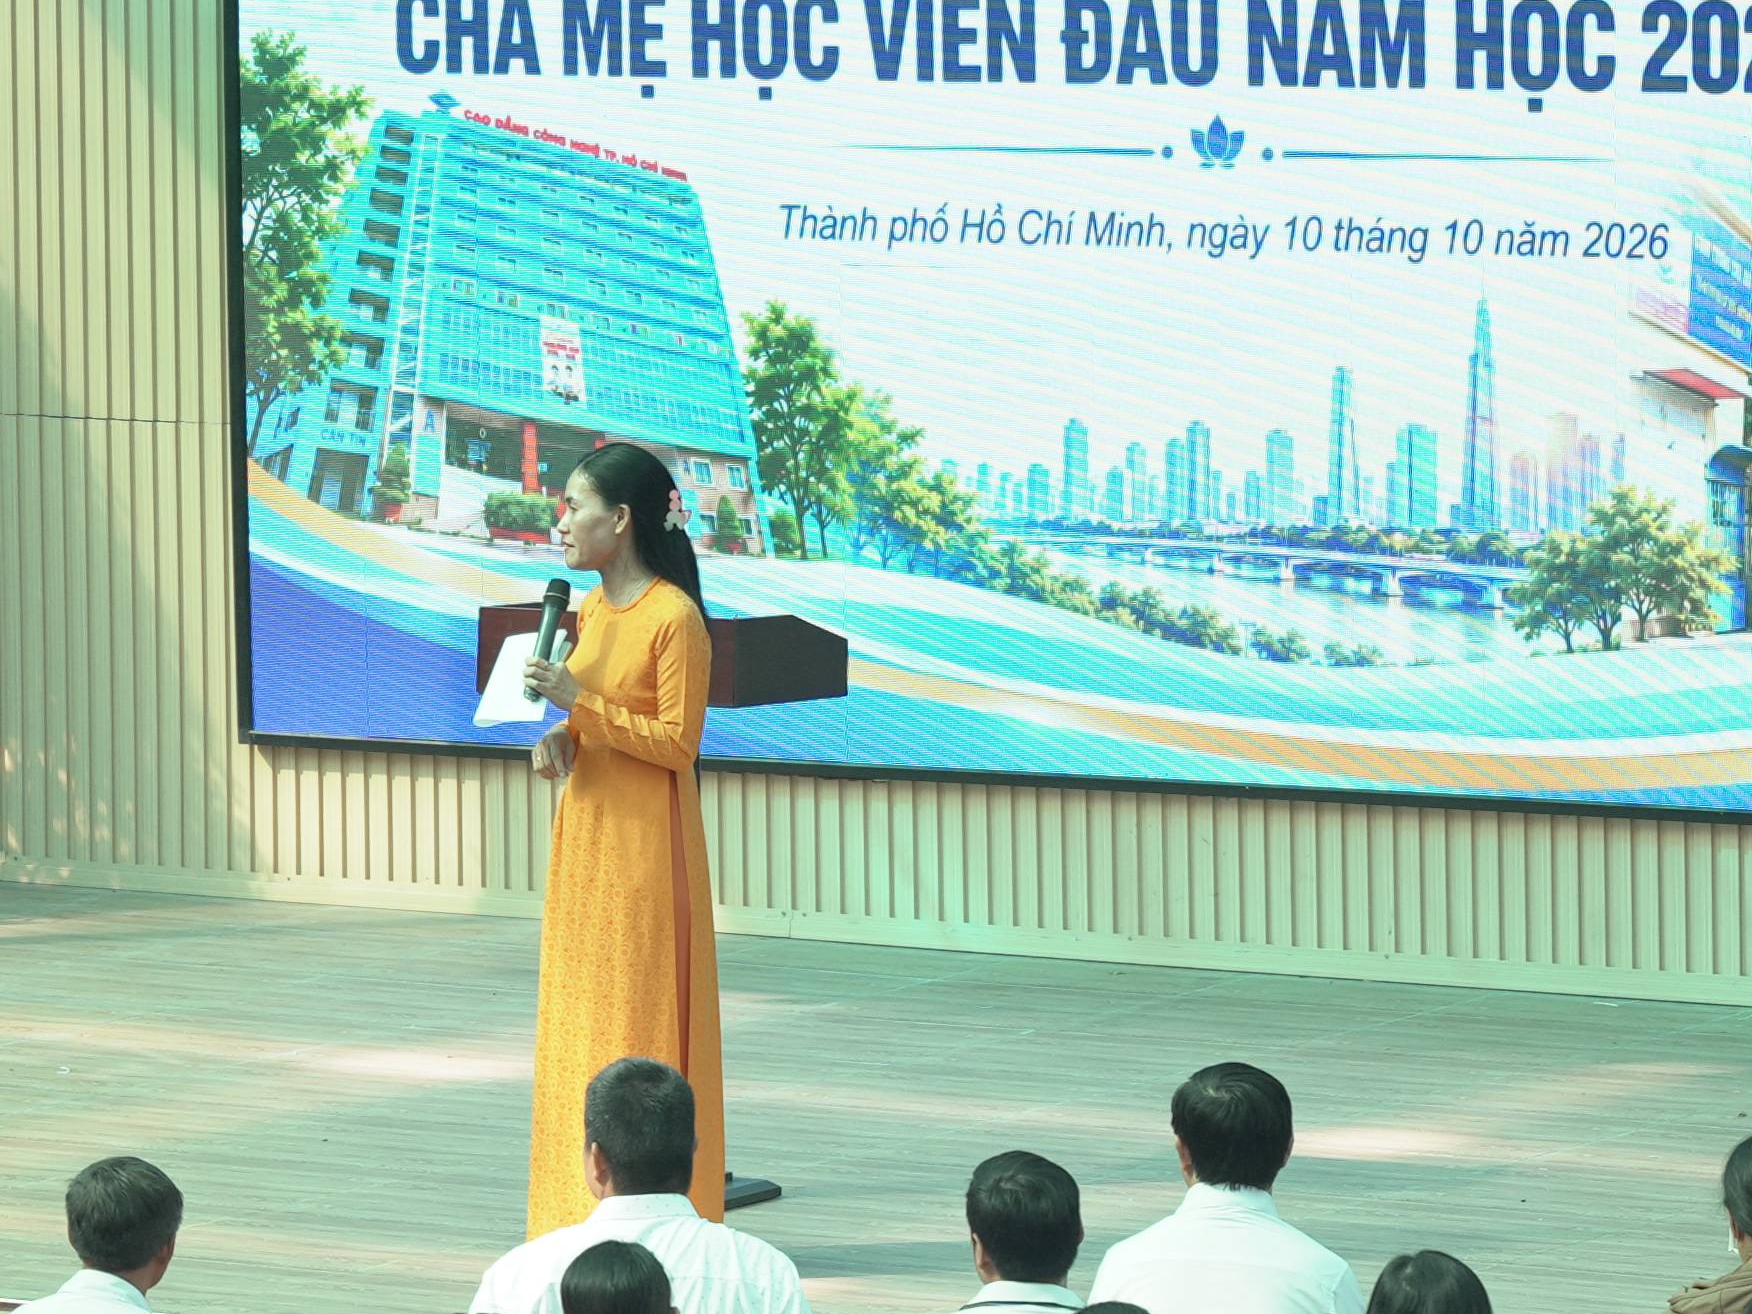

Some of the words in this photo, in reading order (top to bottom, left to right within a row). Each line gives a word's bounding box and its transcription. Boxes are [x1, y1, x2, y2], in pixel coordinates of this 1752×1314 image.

[779, 204, 878, 244] Thành
[888, 202, 950, 252] phố
[960, 201, 1007, 246] Hồ
[1018, 210, 1077, 249] Chí
[1085, 211, 1173, 253] Minh,
[1186, 214, 1271, 259] ngày
[1283, 217, 1322, 253] 10
[1332, 216, 1428, 264] tháng
[1444, 219, 1484, 256] 10
[1496, 222, 1571, 258] năm
[1583, 223, 1670, 261] 2026
